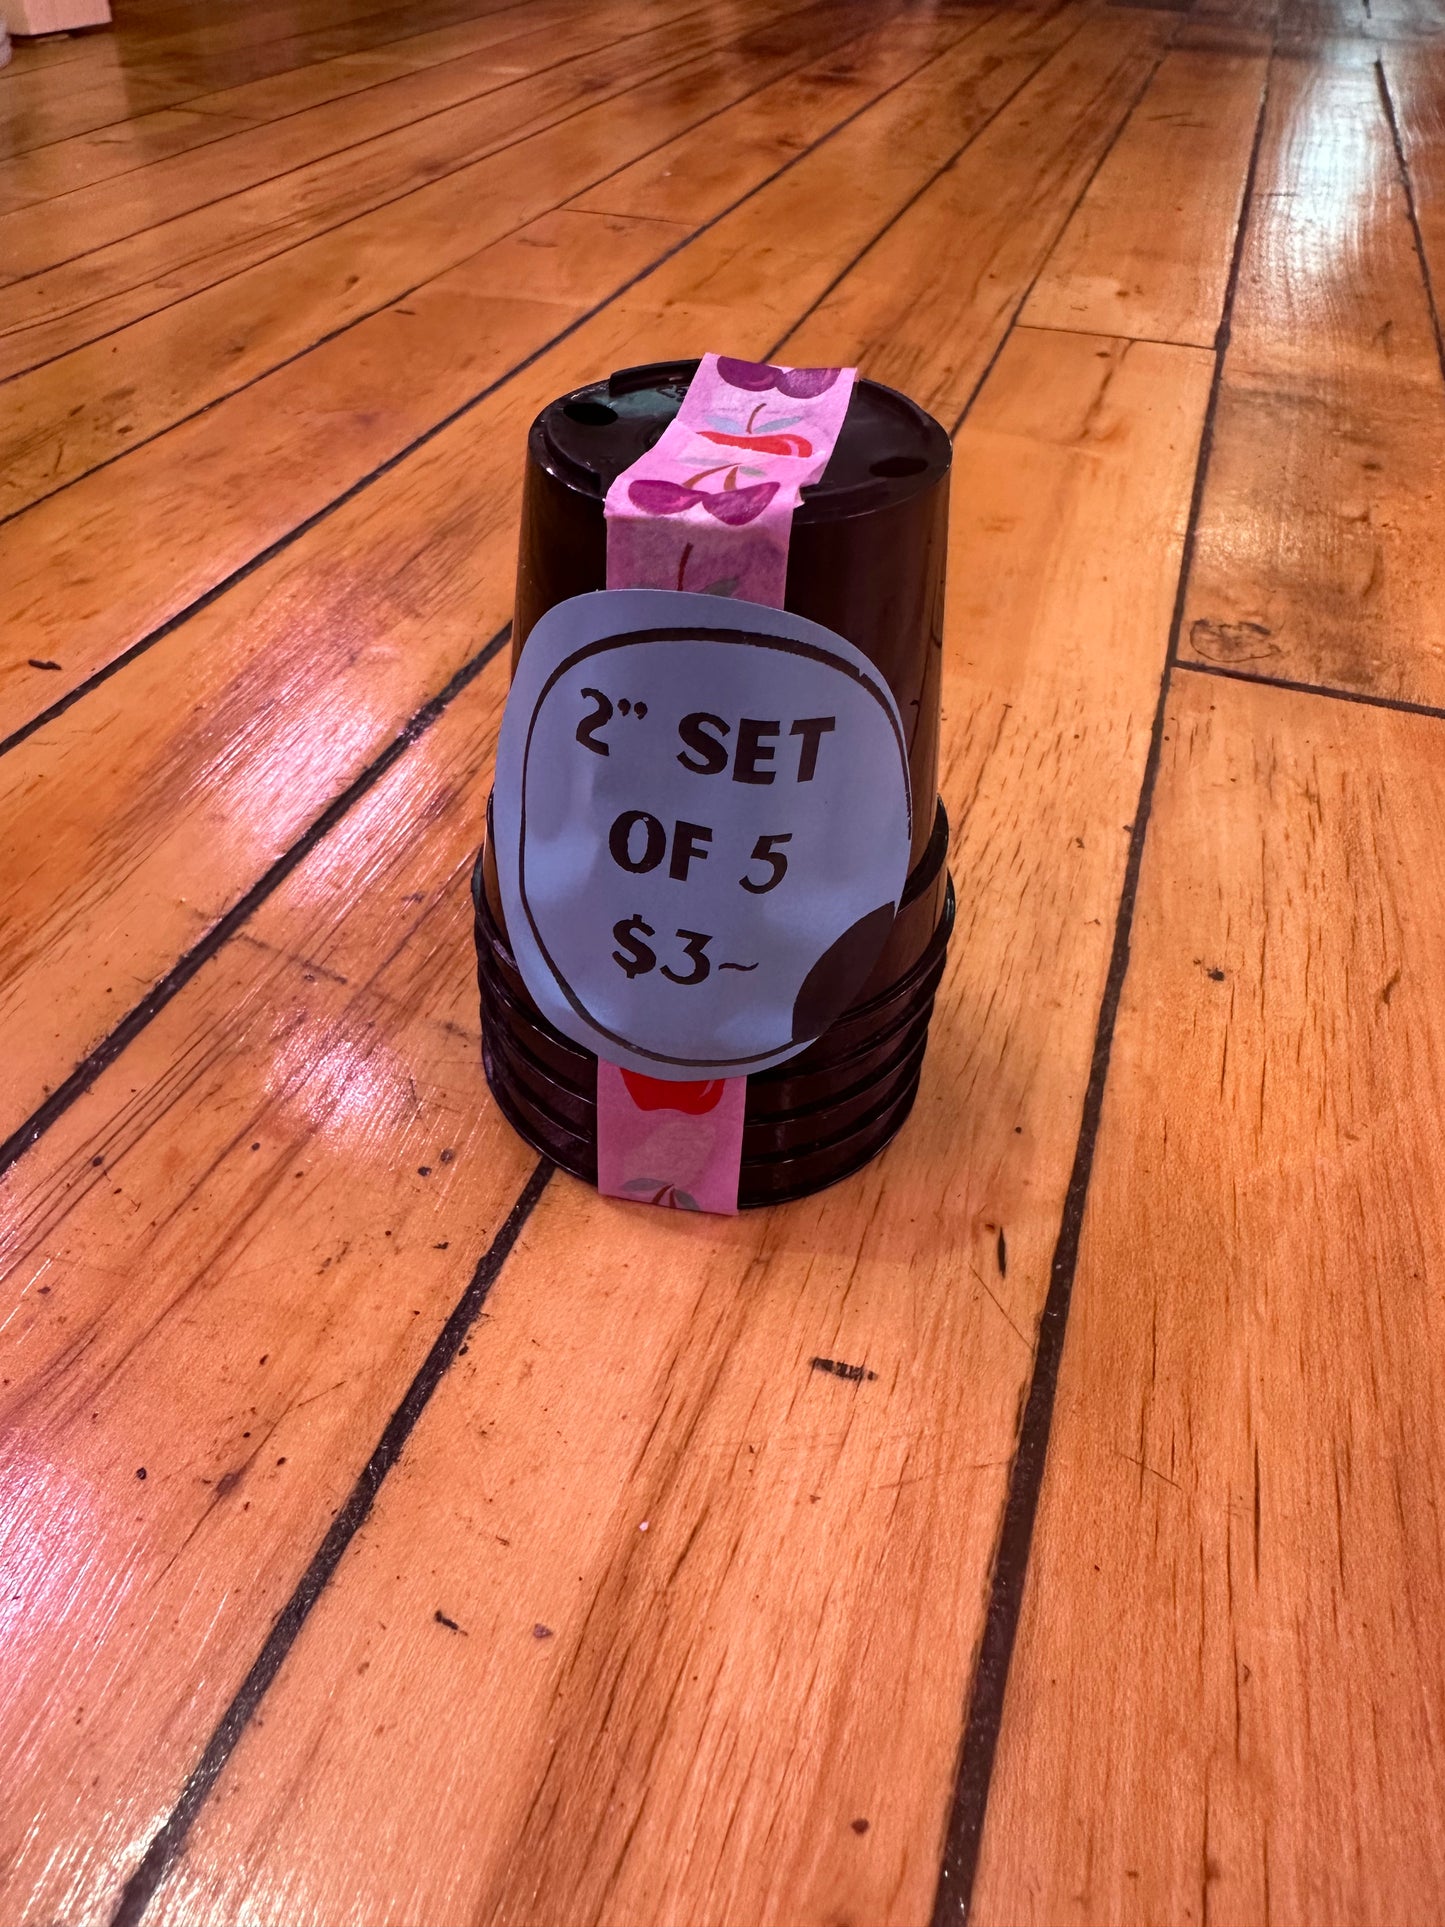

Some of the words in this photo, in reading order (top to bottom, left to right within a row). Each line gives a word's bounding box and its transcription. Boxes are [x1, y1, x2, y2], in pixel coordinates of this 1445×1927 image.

[677, 712, 836, 786] SET
[609, 810, 713, 881] OF
[739, 833, 793, 895] 5
